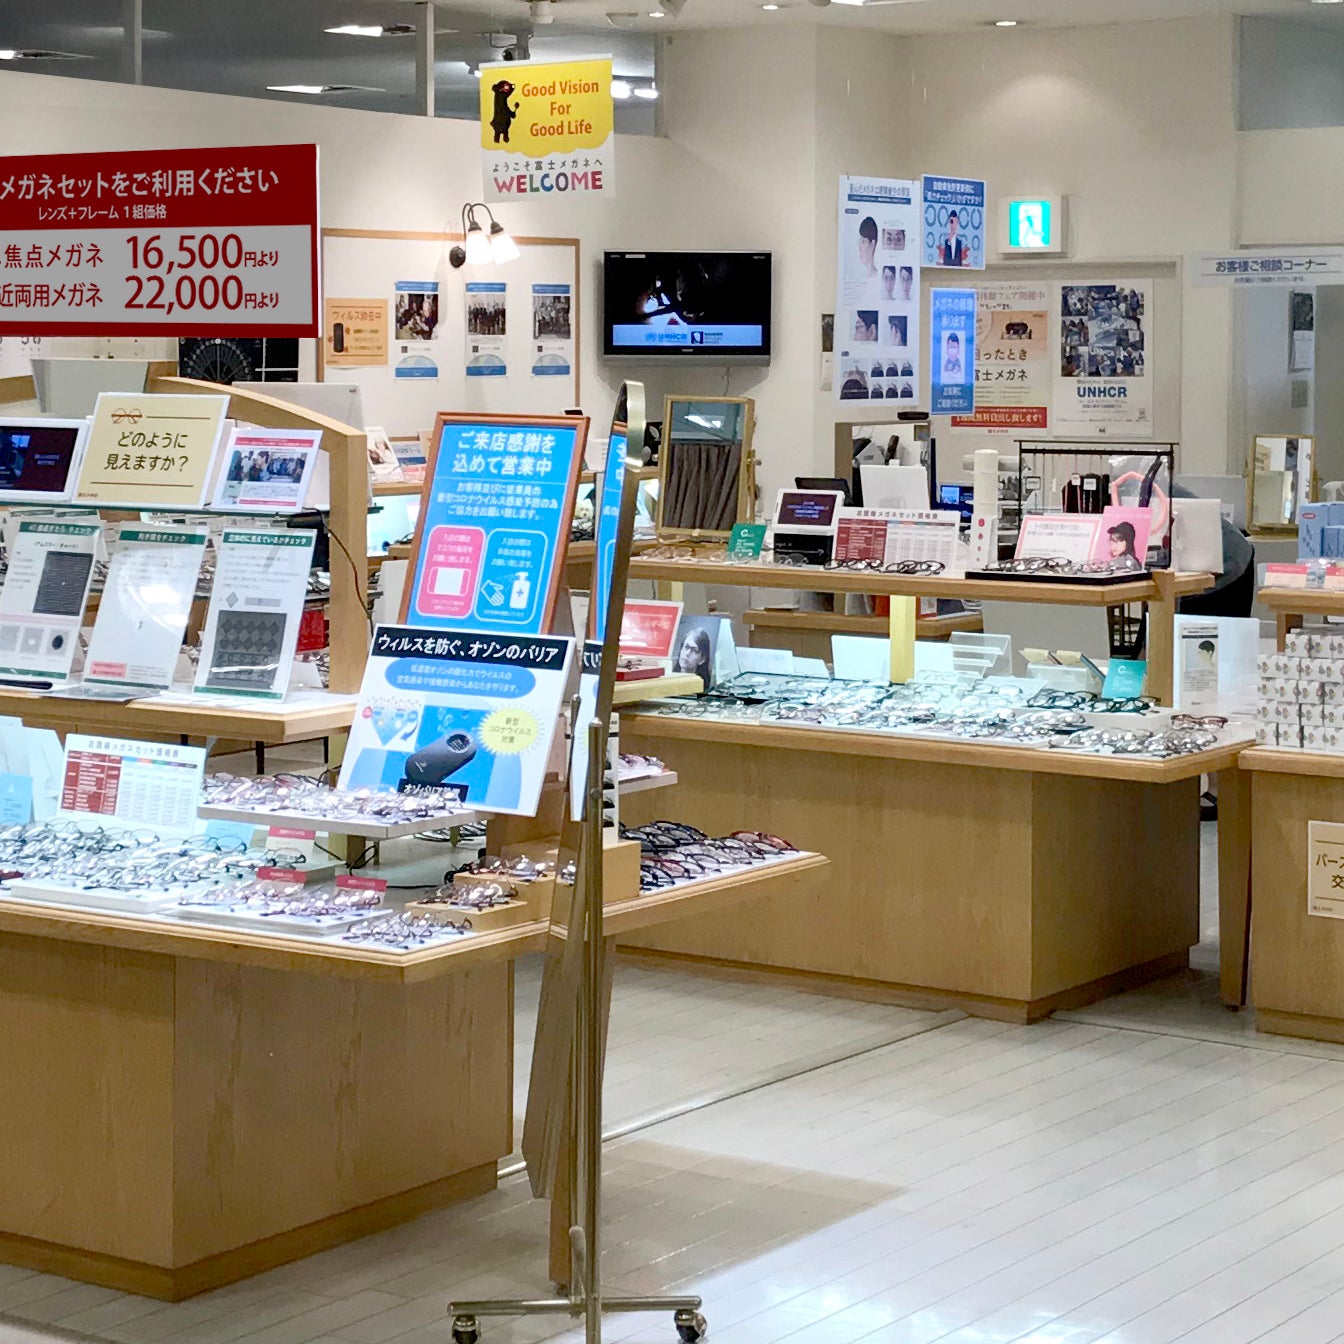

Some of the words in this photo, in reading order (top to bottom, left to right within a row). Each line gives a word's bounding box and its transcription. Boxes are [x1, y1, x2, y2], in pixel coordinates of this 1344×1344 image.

[521, 82, 556, 97] Good
[559, 79, 599, 95] Vision
[550, 101, 572, 116] For
[530, 121, 564, 137] Good
[567, 119, 592, 135] Life
[492, 158, 603, 173] ようこそ富士メガネへ
[493, 171, 603, 194] WELCOME
[126, 233, 279, 275] 16,500円より
[124, 275, 279, 315] 22,000円より
[1077, 386, 1128, 398] UNHCR
[117, 431, 189, 449] どのように
[458, 432, 556, 454] ご来店感謝を
[452, 453, 553, 477] 込めて営業中
